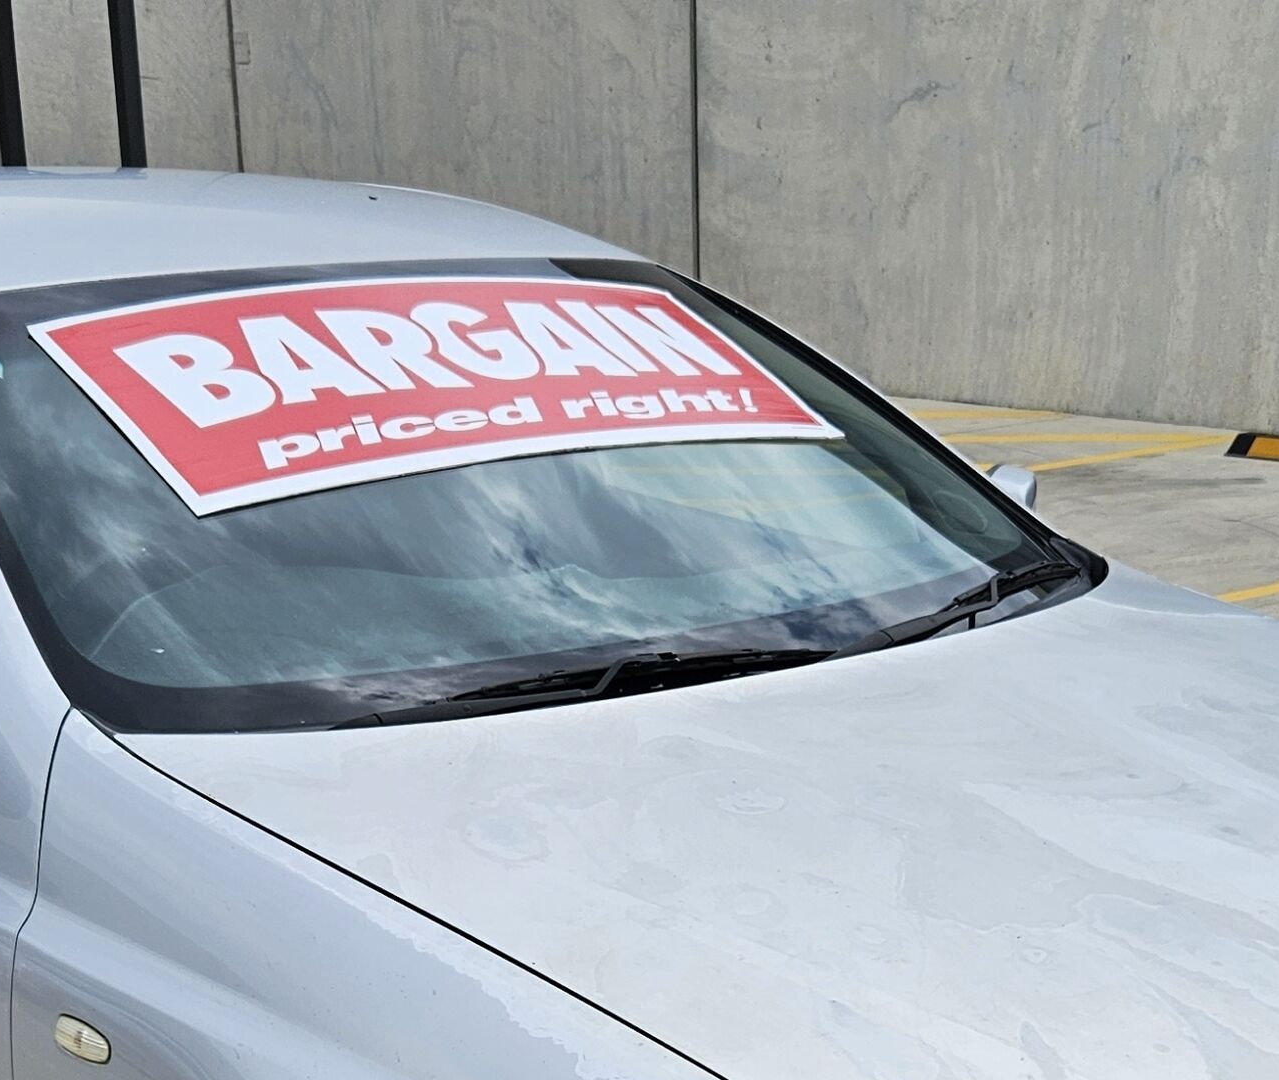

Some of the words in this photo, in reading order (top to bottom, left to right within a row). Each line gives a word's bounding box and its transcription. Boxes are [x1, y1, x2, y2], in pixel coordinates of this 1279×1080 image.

[114, 300, 741, 428] BARGAIN
[257, 393, 543, 470] priced
[565, 386, 759, 424] right!
